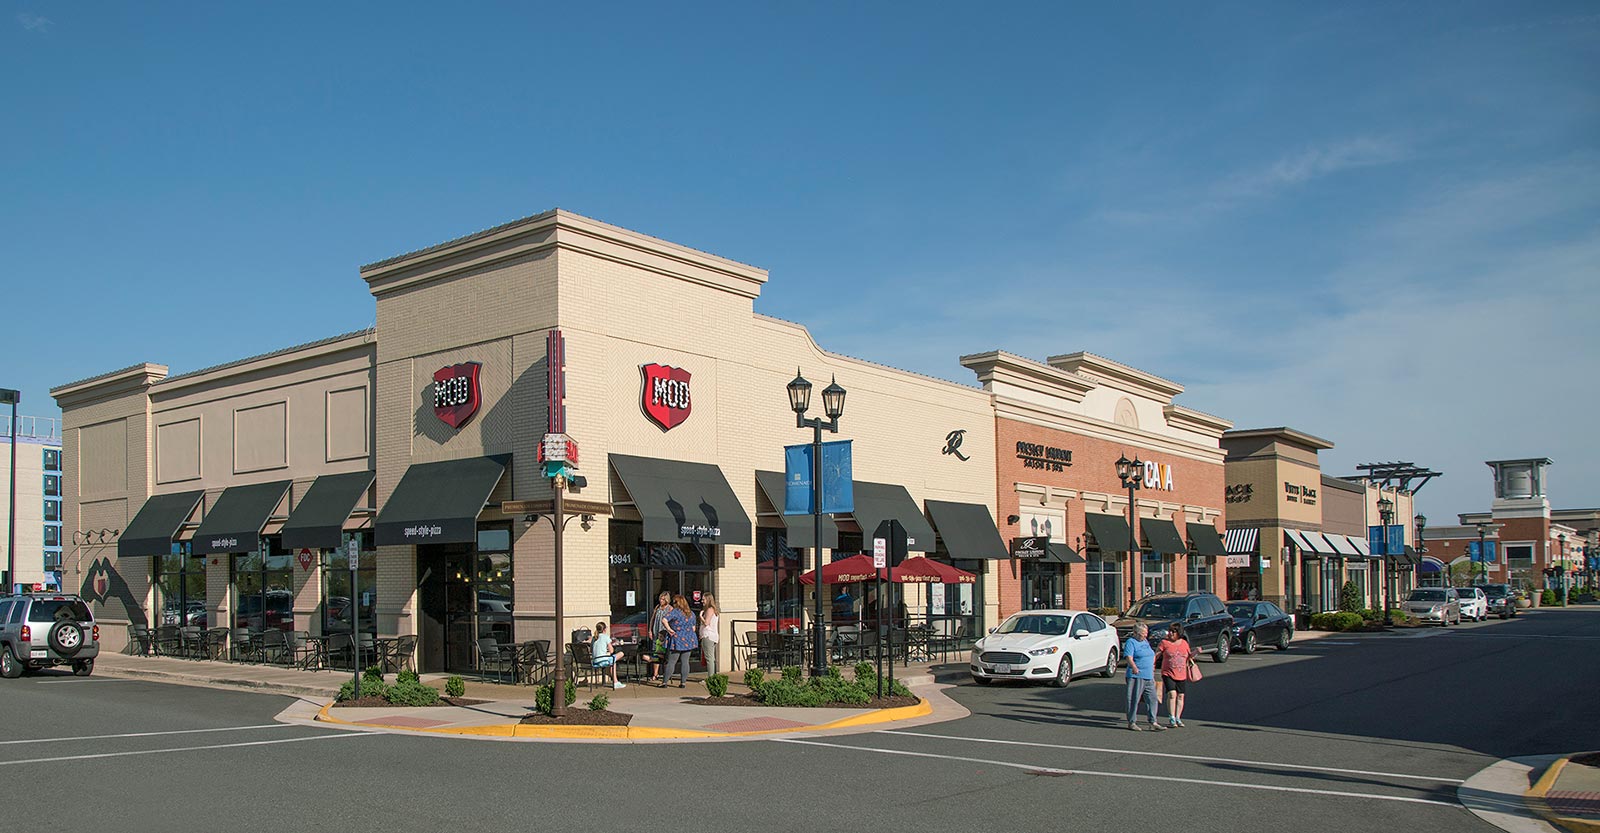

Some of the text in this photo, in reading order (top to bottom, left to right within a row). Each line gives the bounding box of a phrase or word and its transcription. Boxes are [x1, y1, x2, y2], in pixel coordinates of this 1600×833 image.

[435, 377, 469, 407] MOD
[652, 377, 690, 409] MOD
[1143, 461, 1173, 491] CAVA
[1225, 483, 1253, 496] ACK
[404, 524, 441, 538] speed-style-pizza
[681, 525, 720, 538] speed-style-pizza
[300, 553, 311, 562] FDC
[609, 554, 631, 564] 13941
